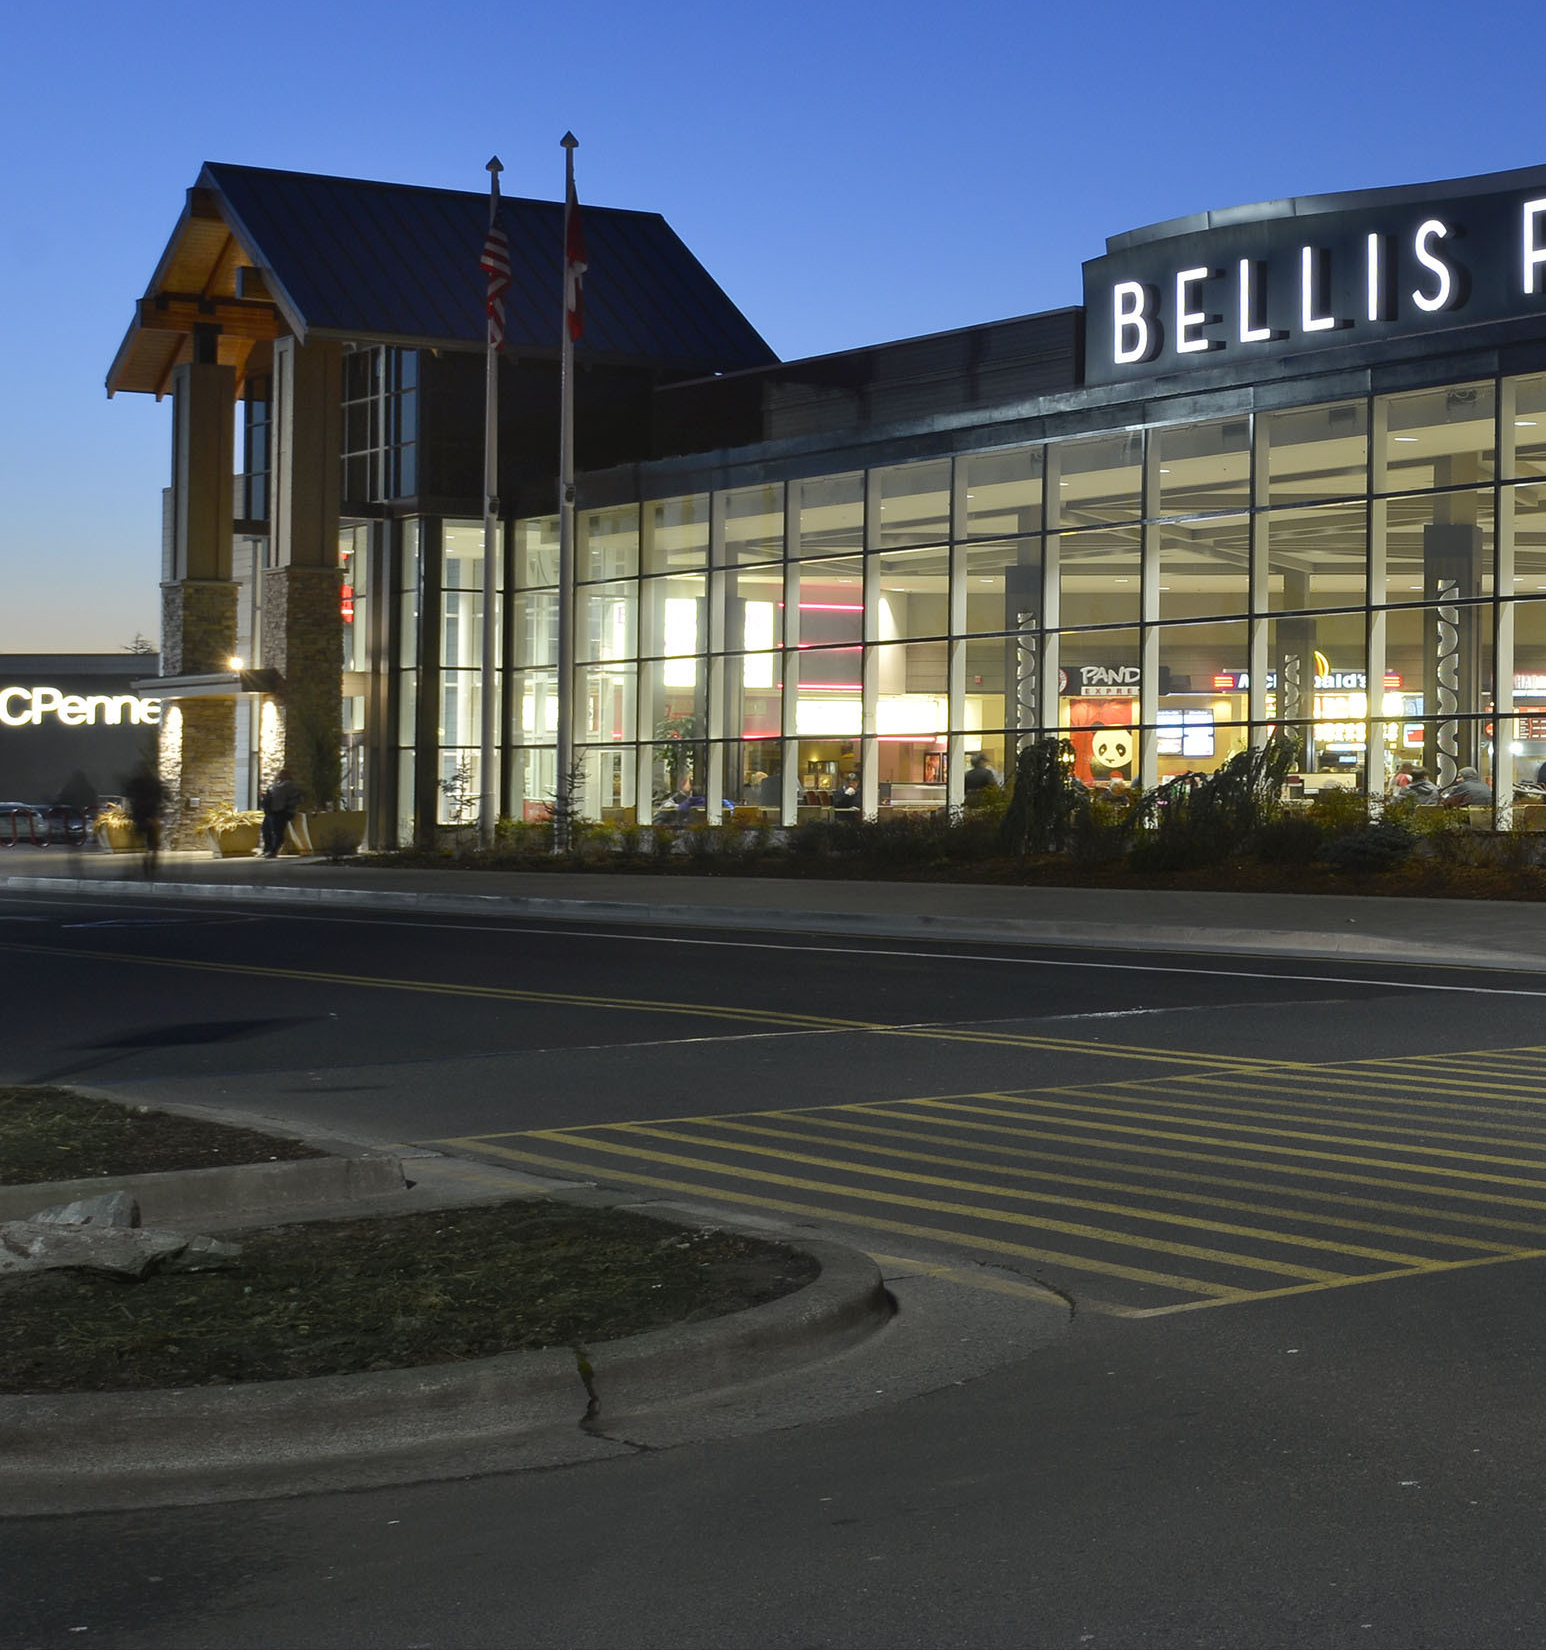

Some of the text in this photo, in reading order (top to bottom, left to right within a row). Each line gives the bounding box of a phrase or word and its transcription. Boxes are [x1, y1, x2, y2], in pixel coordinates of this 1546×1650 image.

[1112, 219, 1451, 365] BELLIS
[1080, 666, 1140, 685] PAND
[1085, 687, 1140, 695] EXPRE
